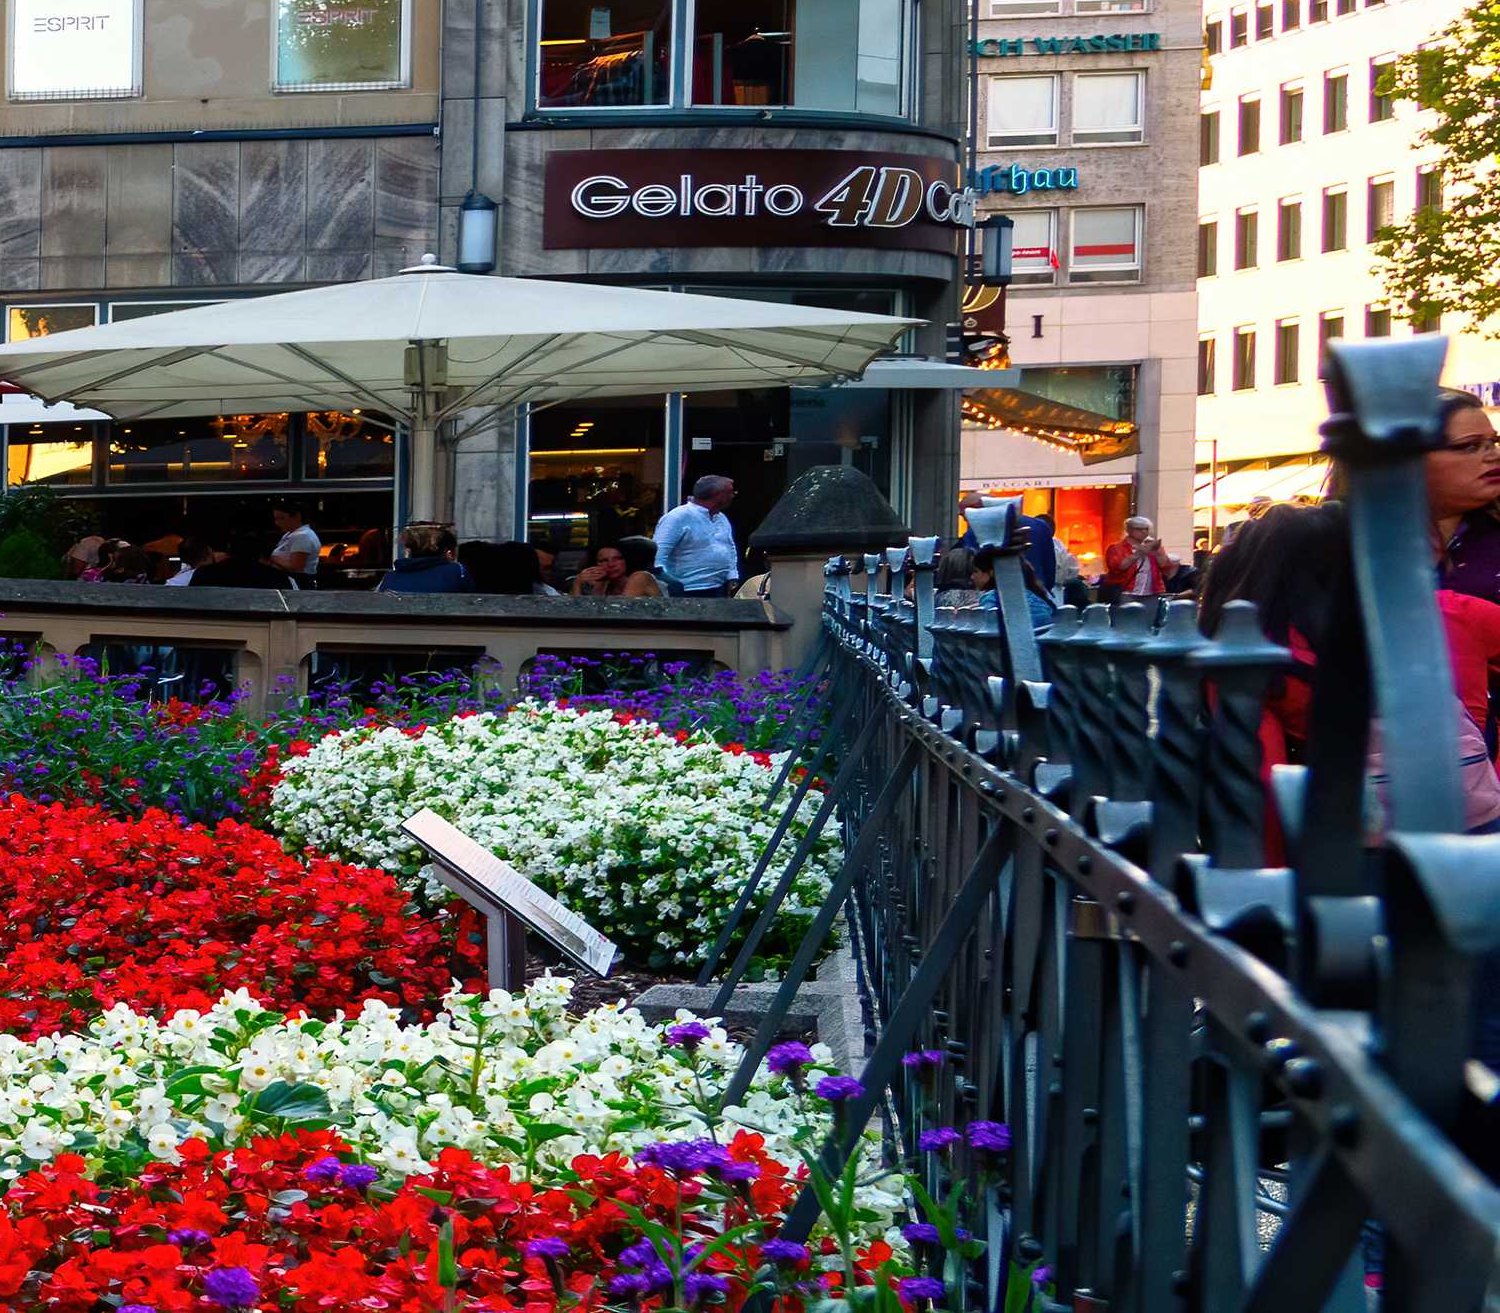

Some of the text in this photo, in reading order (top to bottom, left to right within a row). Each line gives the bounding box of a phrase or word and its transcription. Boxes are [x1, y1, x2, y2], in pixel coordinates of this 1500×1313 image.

[33, 14, 111, 33] ESPRIT
[297, 7, 378, 26] ESPRIT
[1034, 32, 1162, 55] WASSER
[571, 173, 804, 218] Gelato
[814, 165, 924, 228] 4D
